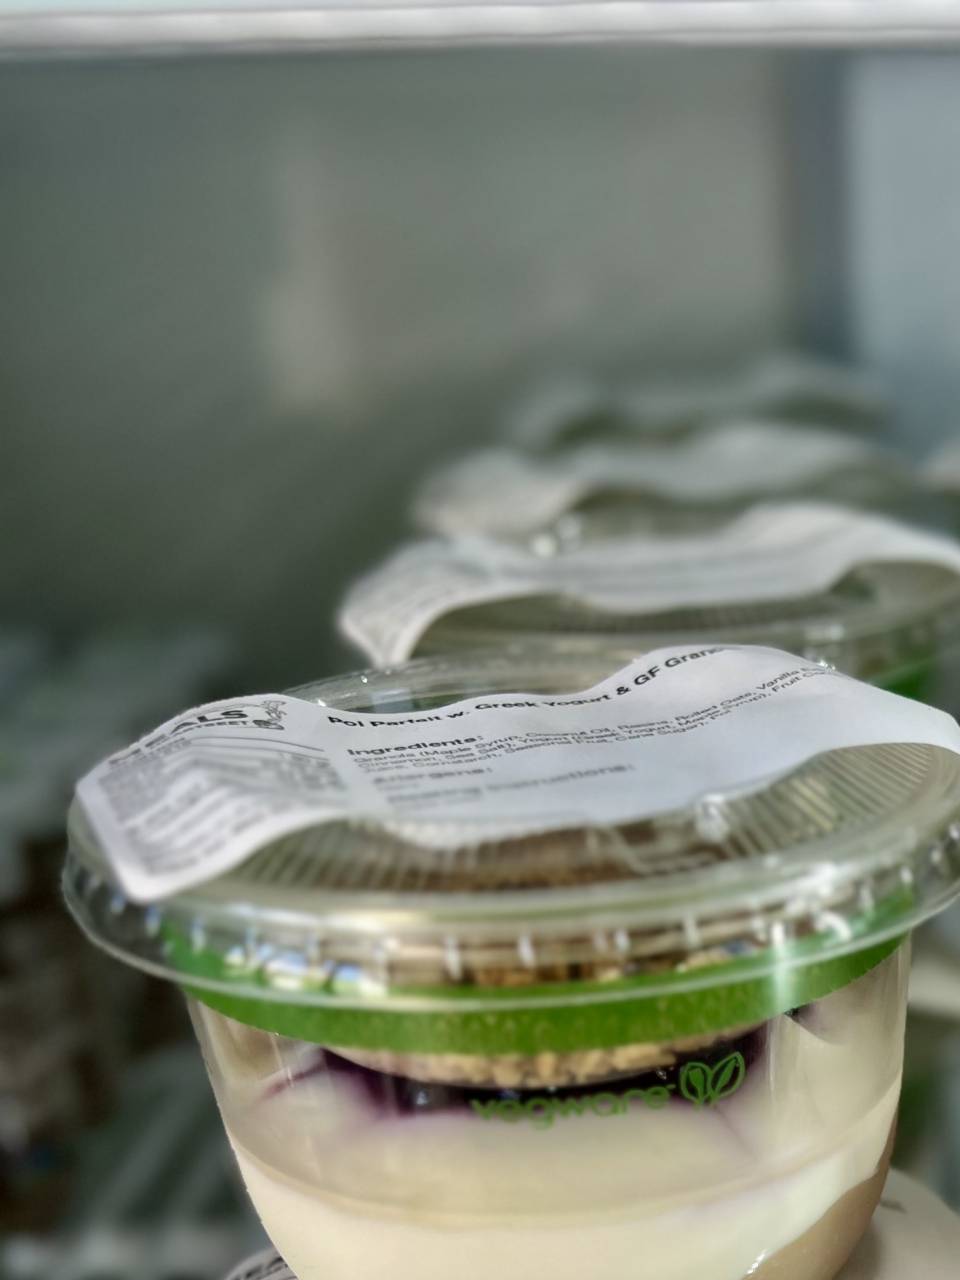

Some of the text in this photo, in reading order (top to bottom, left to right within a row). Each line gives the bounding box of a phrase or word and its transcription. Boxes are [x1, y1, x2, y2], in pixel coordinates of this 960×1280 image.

[475, 701, 537, 711] Greek
[616, 685, 630, 696] &
[634, 666, 662, 687] GF
[665, 646, 724, 668] Gran
[347, 736, 483, 755] Ingredients:
[470, 1085, 672, 1131] vegware
